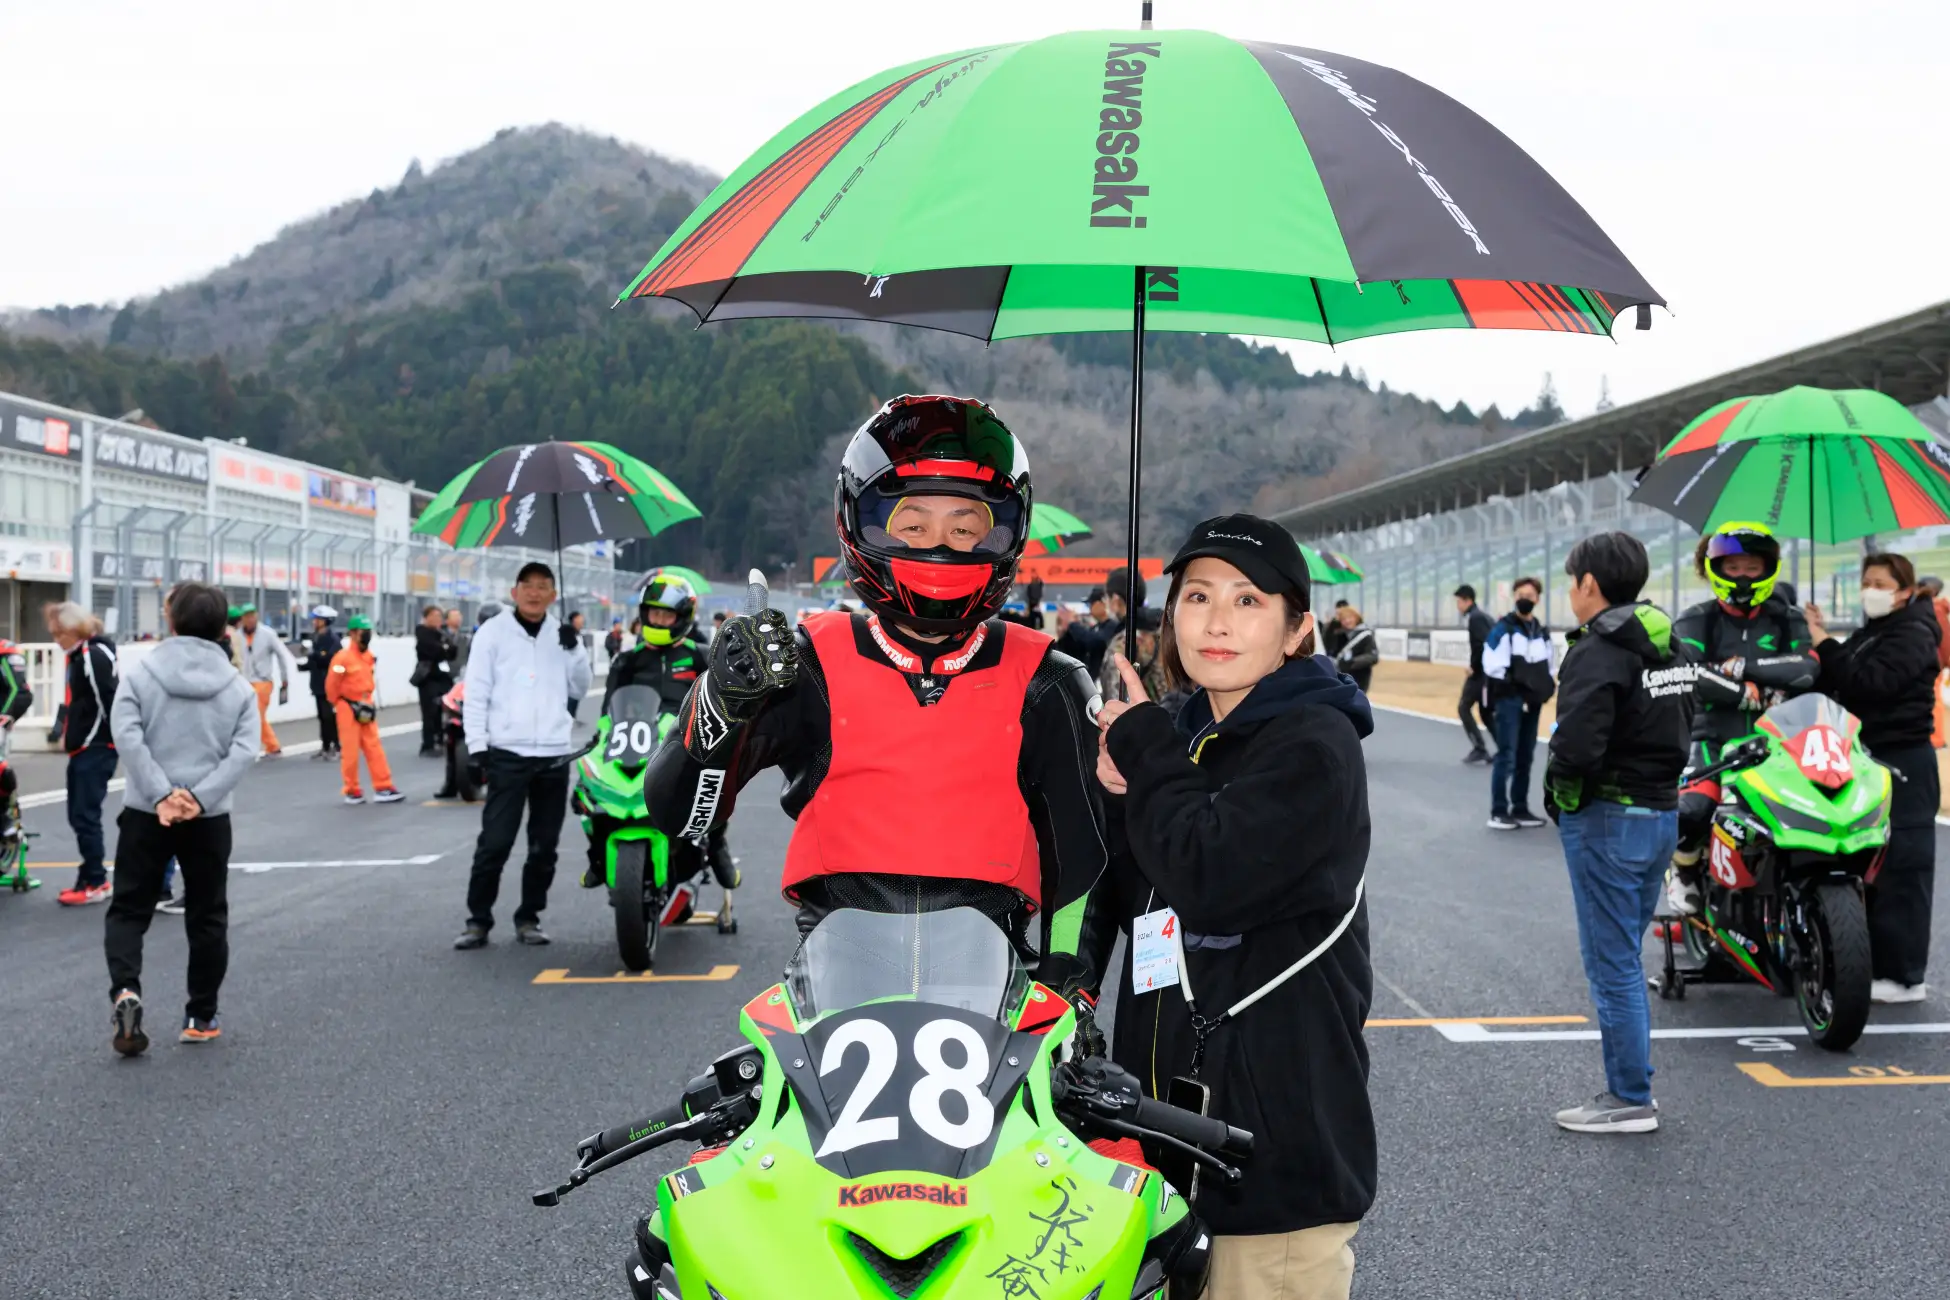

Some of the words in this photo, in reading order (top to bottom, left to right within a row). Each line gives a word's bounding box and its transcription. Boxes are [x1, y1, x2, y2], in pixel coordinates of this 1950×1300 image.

[1090, 42, 1162, 228] Kawasaki
[608, 720, 652, 757] 50
[1801, 729, 1850, 773] 45
[1711, 838, 1738, 886] 45
[1161, 916, 1175, 939] 4
[1146, 976, 1153, 988] 4
[815, 1018, 994, 1158] 28
[839, 1183, 968, 1207] Kawasaki
